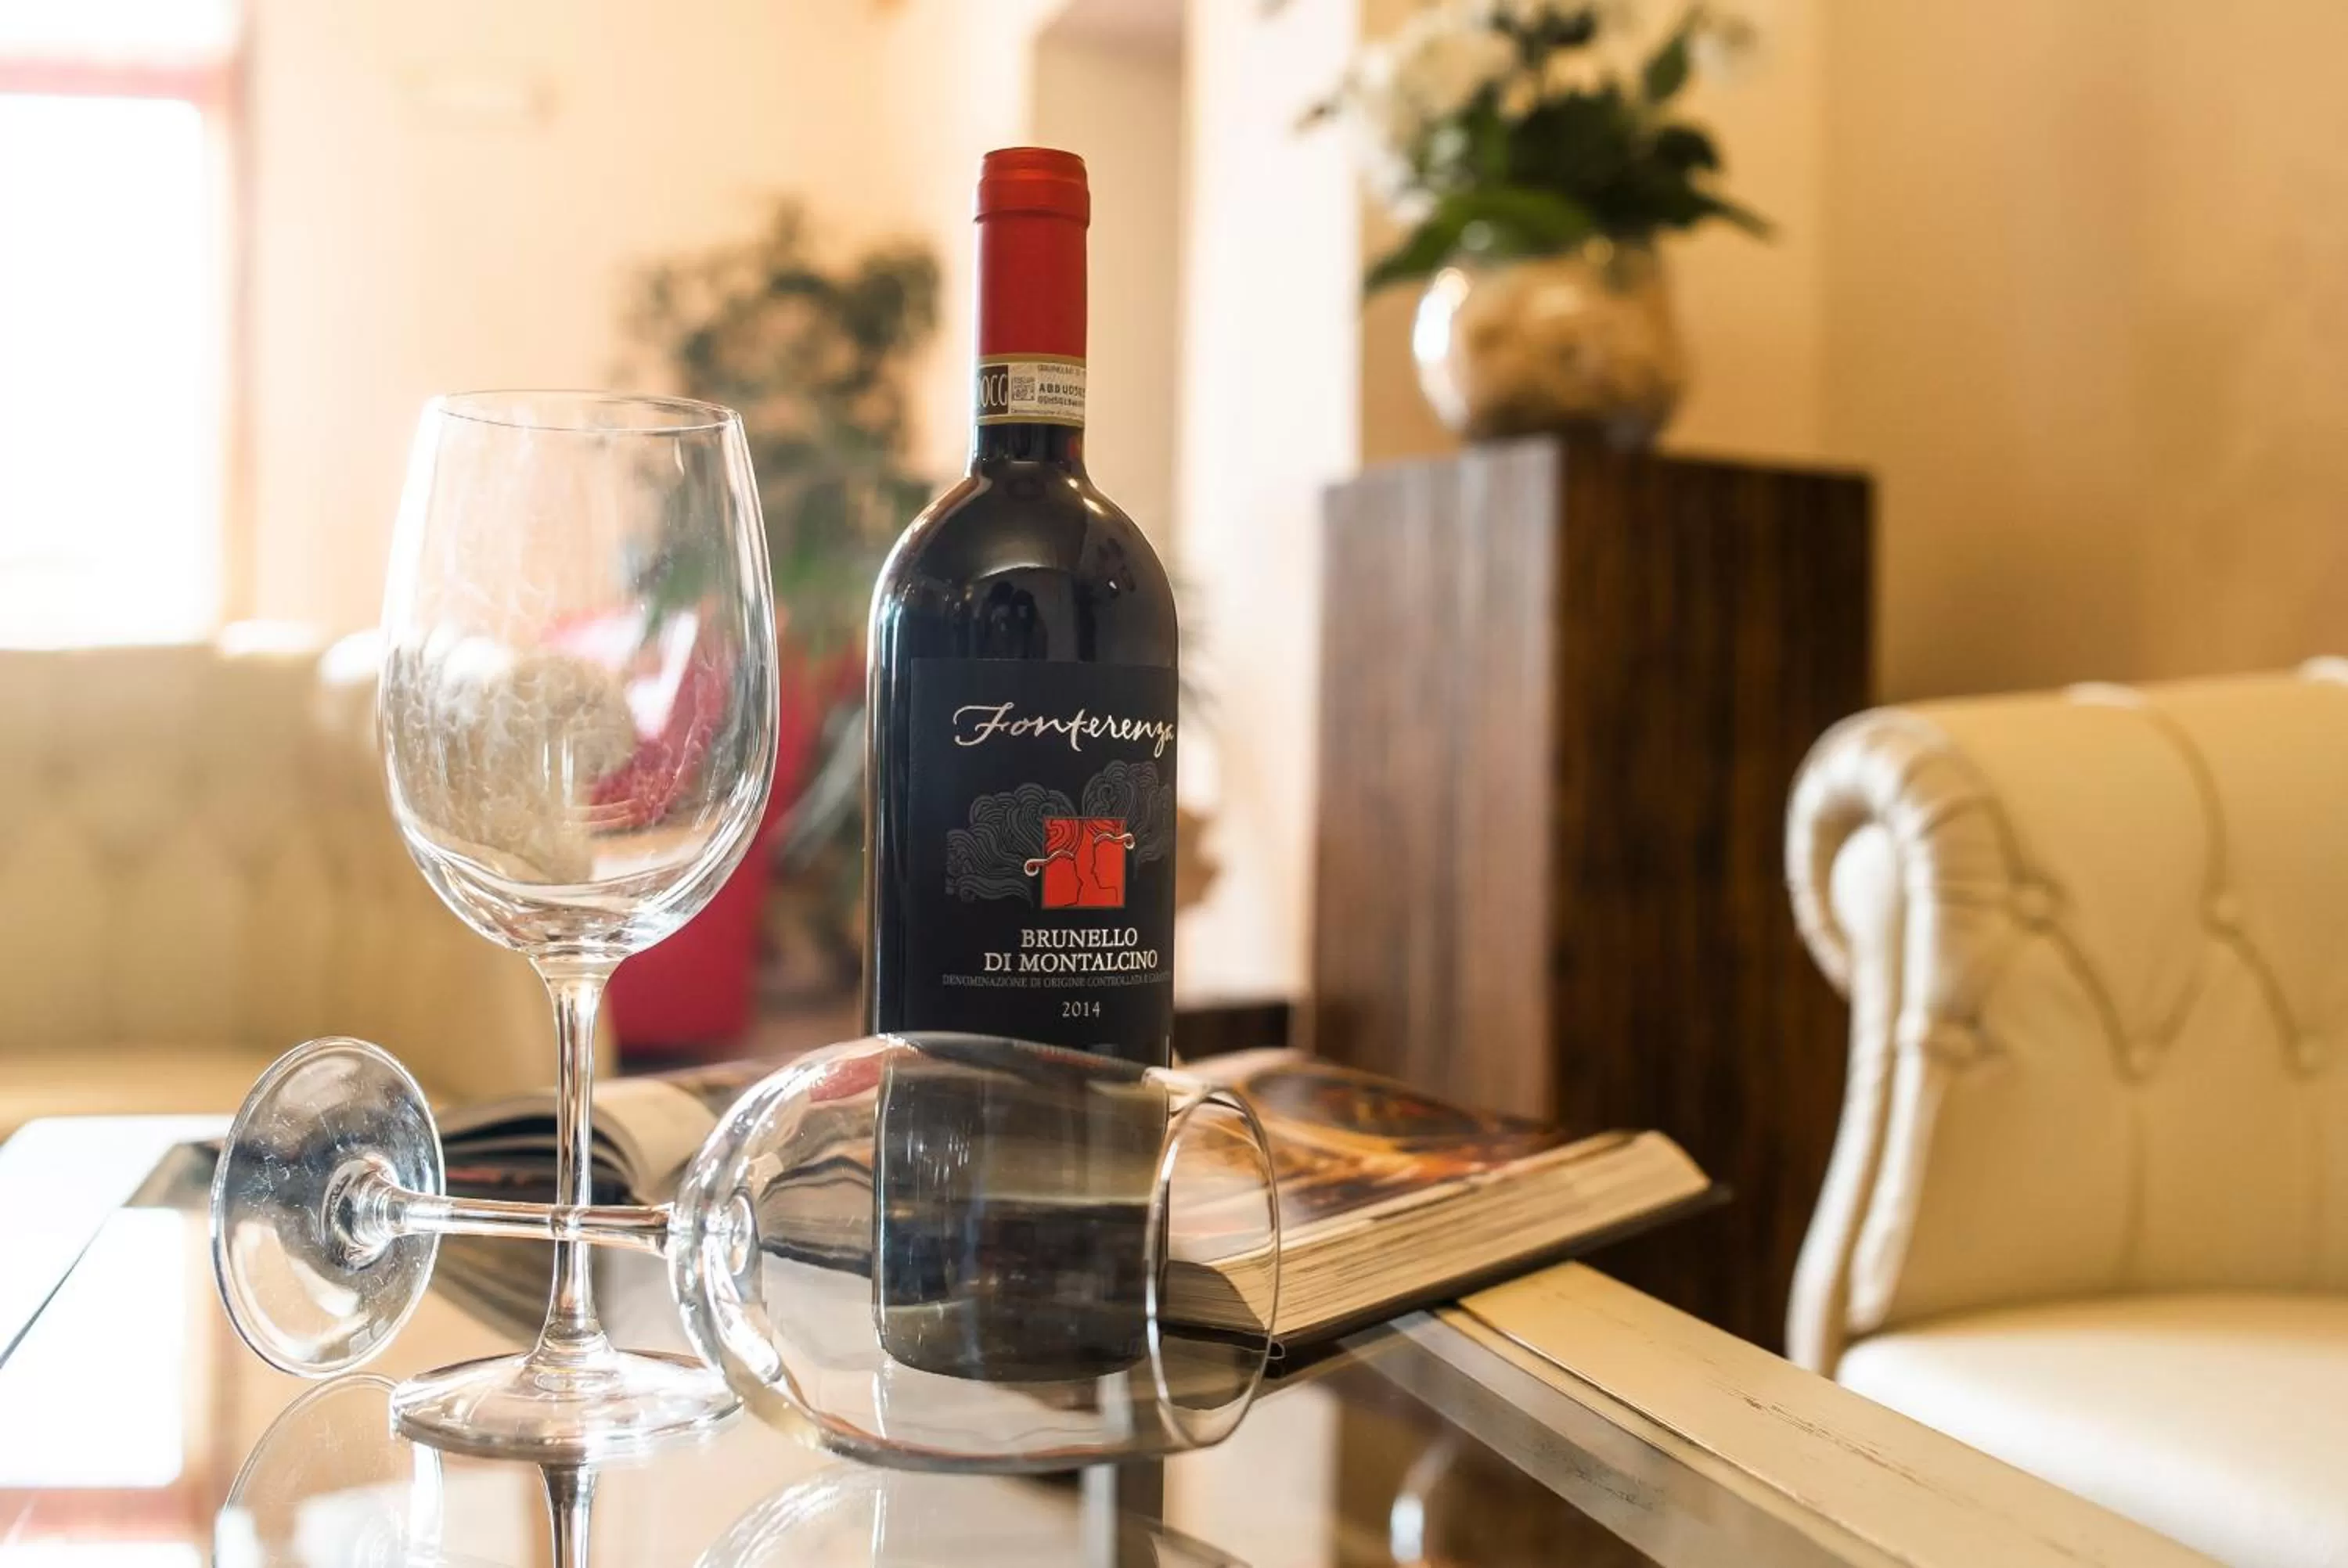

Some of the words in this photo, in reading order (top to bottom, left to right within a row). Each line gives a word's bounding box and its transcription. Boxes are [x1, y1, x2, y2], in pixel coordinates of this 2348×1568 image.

[978, 373, 1007, 407] OCG
[953, 702, 1173, 757] Fonterenza
[1021, 927, 1137, 948] BRUNELLO
[984, 952, 1012, 971] DI
[1018, 949, 1158, 972] MONTALCINO
[1062, 1001, 1100, 1017] 2014
